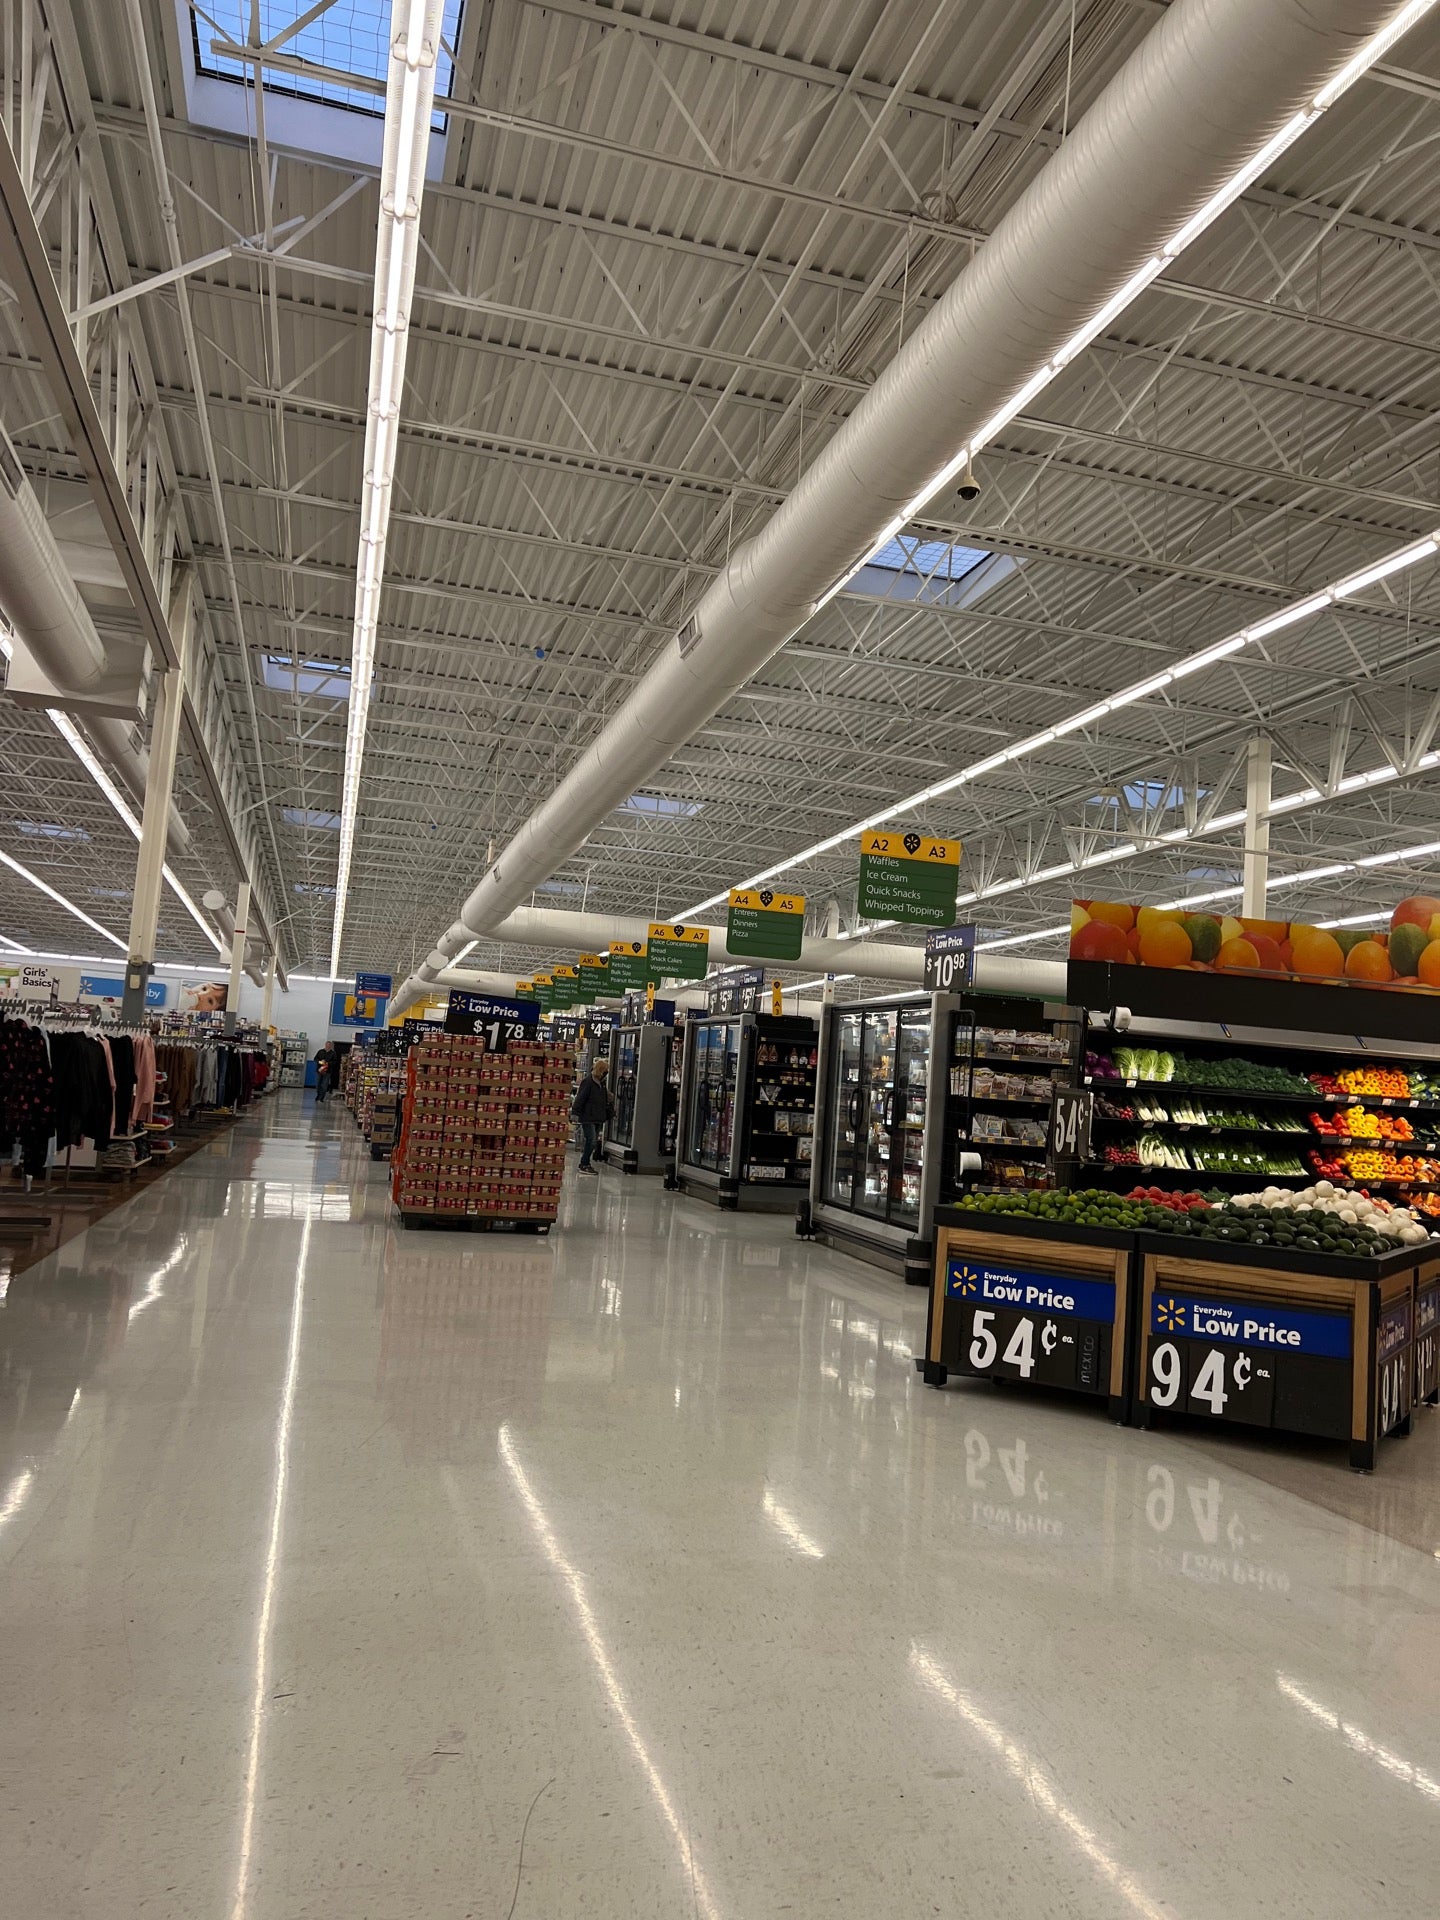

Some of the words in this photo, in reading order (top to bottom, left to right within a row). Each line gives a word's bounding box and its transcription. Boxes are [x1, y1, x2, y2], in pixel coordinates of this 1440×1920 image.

[871, 839, 889, 851] A2
[928, 846, 946, 858] A3
[868, 855, 900, 867] Waffles
[866, 870, 878, 880] Ice
[880, 872, 908, 883] Cream
[866, 884, 891, 896] Quick
[892, 888, 920, 900] Snacks
[734, 896, 748, 904] A4
[780, 900, 794, 910] A5
[865, 899, 904, 912] Whipped
[906, 904, 944, 918] Toppings
[734, 908, 758, 917] Entrees
[733, 919, 758, 928] Dinners
[936, 940, 948, 949] Low
[948, 936, 962, 948] Price
[23, 967, 48, 978] Girls'
[650, 964, 679, 974] Vegetables
[22, 977, 51, 988] Basics
[469, 1003, 492, 1014] Low
[492, 1006, 519, 1018] Price
[984, 1272, 1017, 1284] Everyday
[983, 1280, 1022, 1302] Low
[1026, 1286, 1074, 1310] Price
[1194, 1305, 1232, 1318] Everyday
[1194, 1314, 1240, 1336] Low
[1244, 1320, 1301, 1346] Price
[1062, 1336, 1074, 1344] ea.
[1257, 1368, 1270, 1378] ea.
